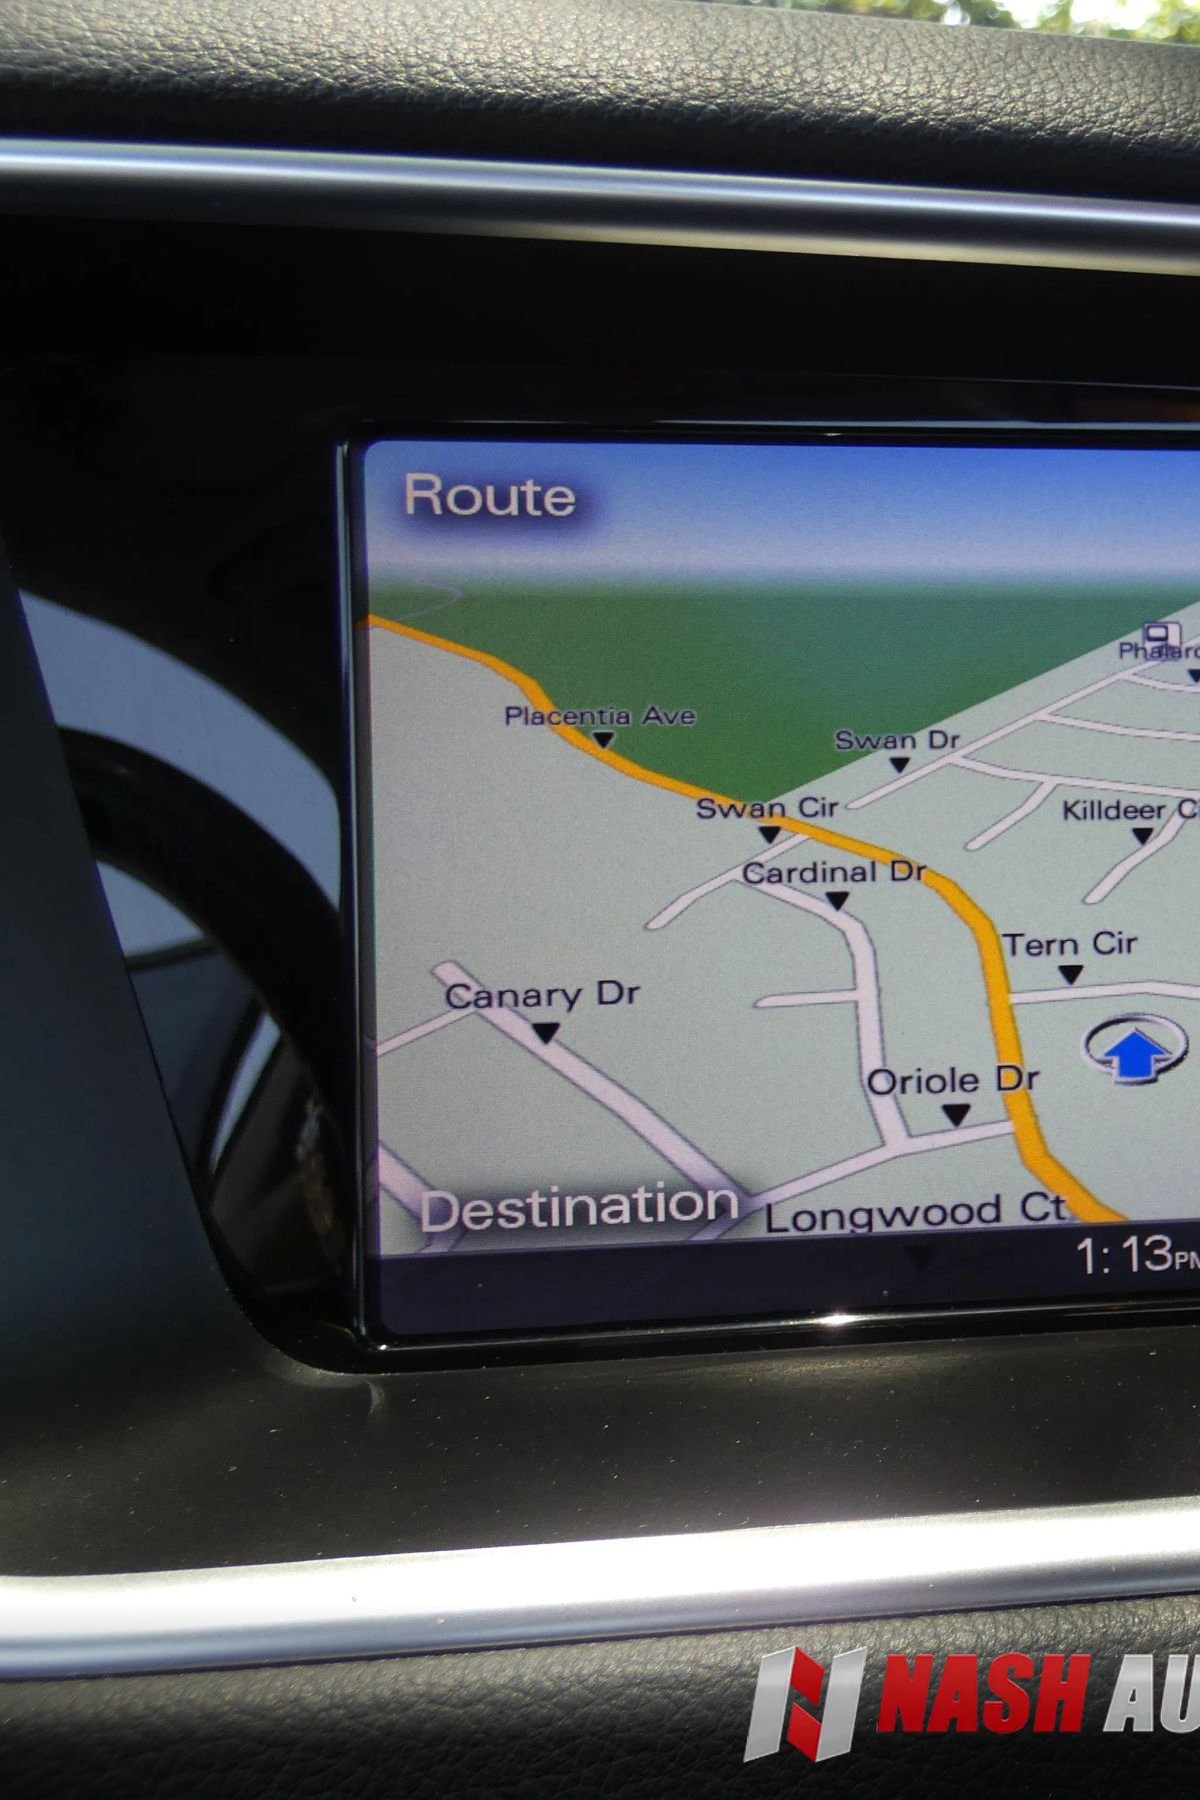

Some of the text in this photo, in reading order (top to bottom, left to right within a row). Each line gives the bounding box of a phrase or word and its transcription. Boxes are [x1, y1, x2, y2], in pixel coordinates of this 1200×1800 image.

[405, 472, 577, 517] Route
[504, 705, 697, 728] Placentia Ave
[835, 730, 961, 751] Swan Dr
[696, 797, 840, 820] Swan Cir
[1062, 799, 1167, 822] Killdeer
[742, 860, 928, 885] Cardinal Dr
[1002, 930, 1139, 958] Tern Cir
[445, 980, 642, 1014] Canary Dr
[866, 1065, 1041, 1097] Oriole Dr
[420, 1181, 741, 1234] Destination
[764, 1190, 1067, 1234] Longwood Ct
